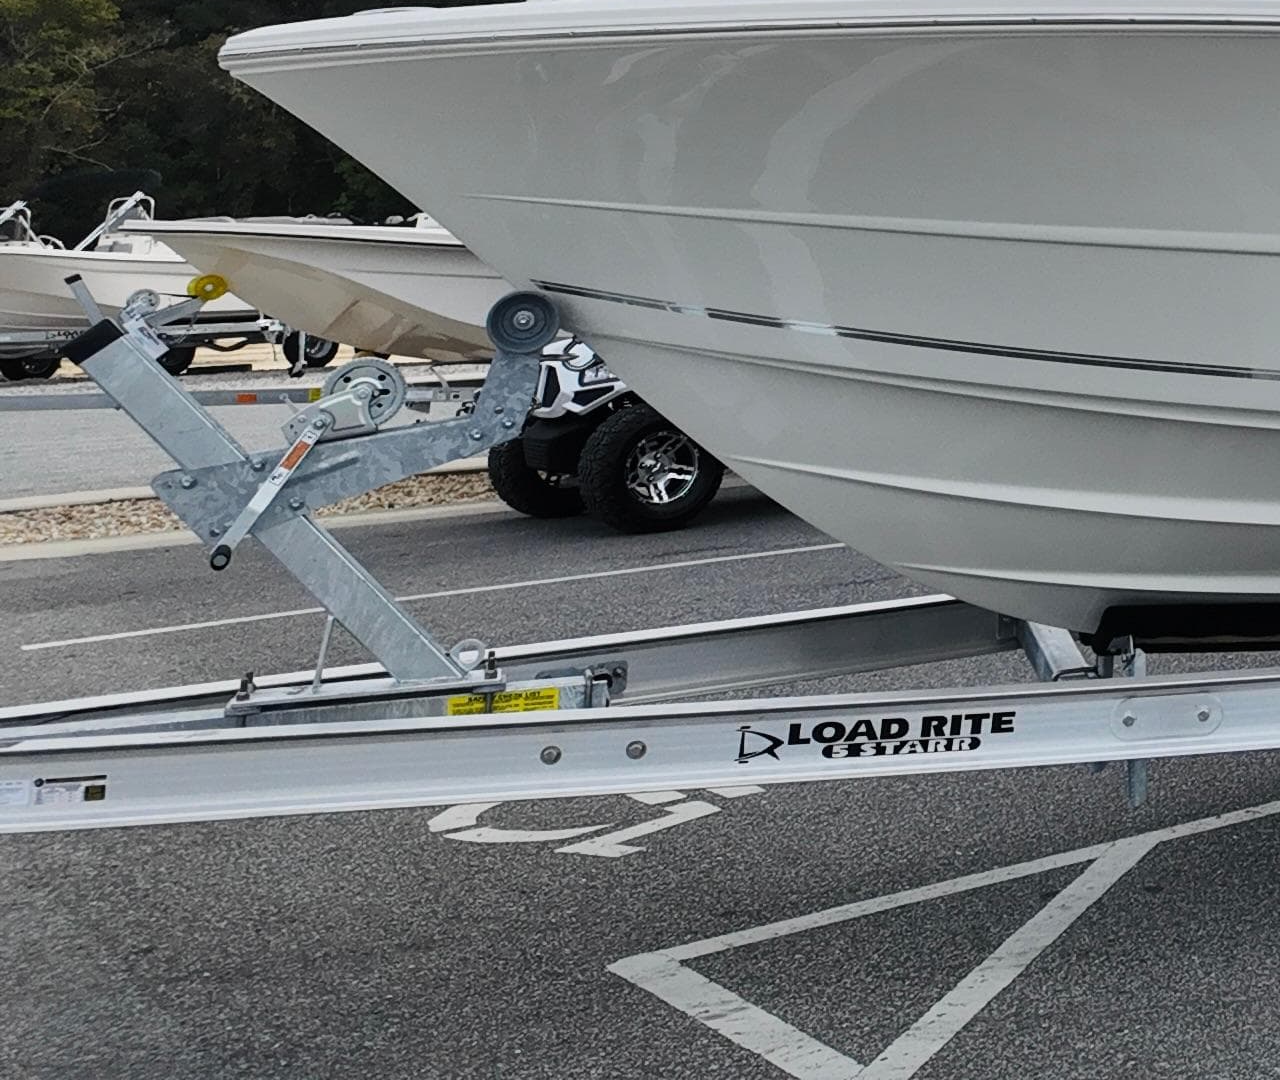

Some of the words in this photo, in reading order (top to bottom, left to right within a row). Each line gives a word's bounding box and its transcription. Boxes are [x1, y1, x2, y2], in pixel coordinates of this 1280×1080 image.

[787, 717, 910, 746] LOAD
[919, 711, 1017, 738] RITE
[830, 743, 850, 758] 5
[859, 736, 973, 756] STARR
